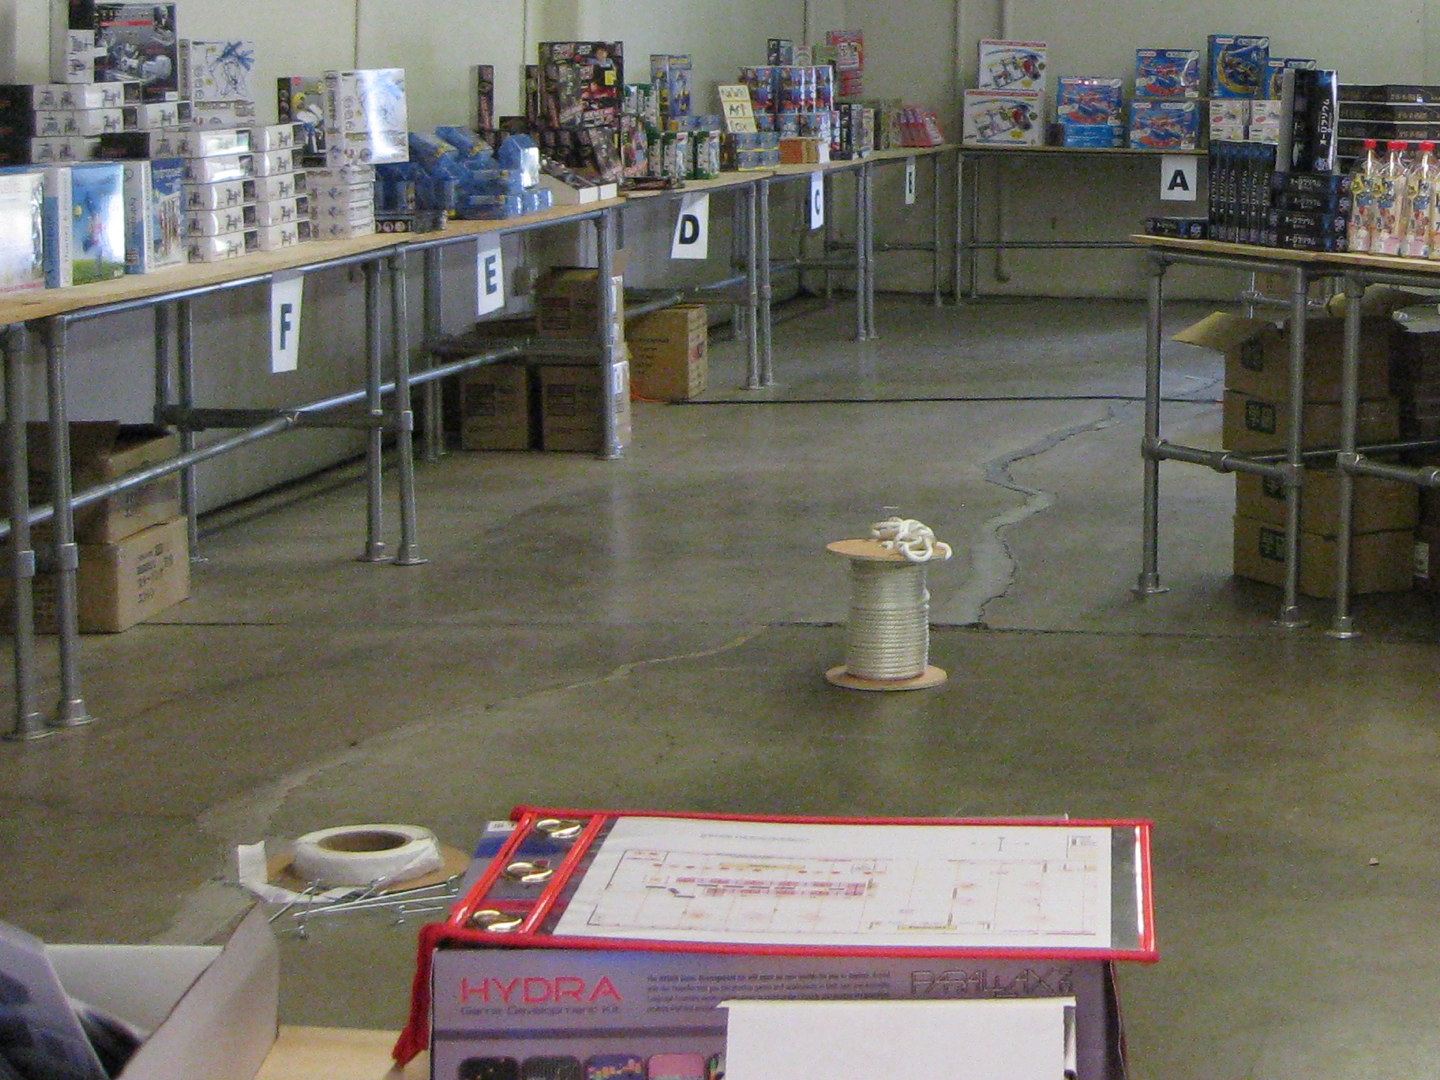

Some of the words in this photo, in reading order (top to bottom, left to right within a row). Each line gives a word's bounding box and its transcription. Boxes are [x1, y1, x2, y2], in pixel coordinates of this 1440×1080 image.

[1167, 169, 1189, 191] A
[814, 189, 821, 215] C
[678, 213, 700, 245] D
[485, 255, 497, 295] E
[280, 303, 293, 351] F
[460, 975, 623, 1004] HYDRA
